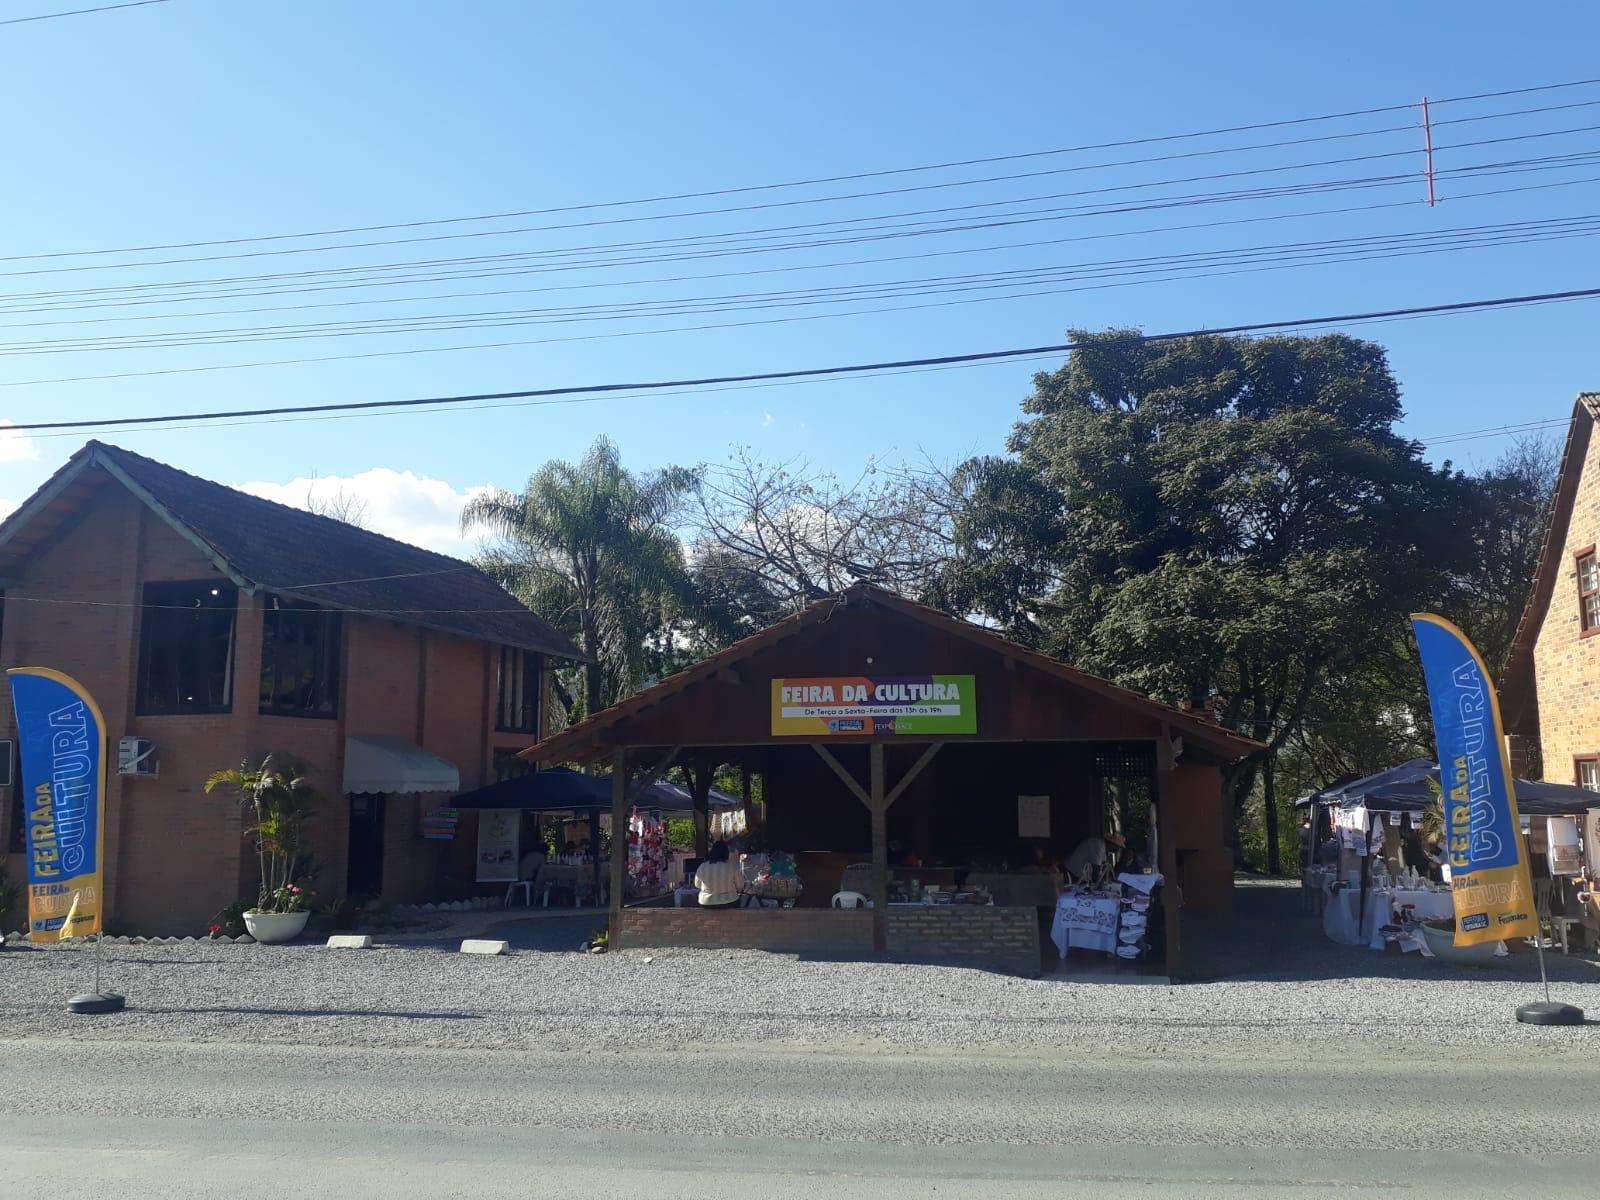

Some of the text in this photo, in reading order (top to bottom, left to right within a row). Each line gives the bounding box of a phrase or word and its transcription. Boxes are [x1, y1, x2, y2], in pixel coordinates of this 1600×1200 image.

[781, 683, 960, 703] FEIRA DA CULTURA
[48, 700, 92, 873] CULTURA
[1450, 755, 1472, 868] FEIRA DA
[1452, 659, 1502, 862] CULTURA
[31, 782, 60, 878] FEIRA DA
